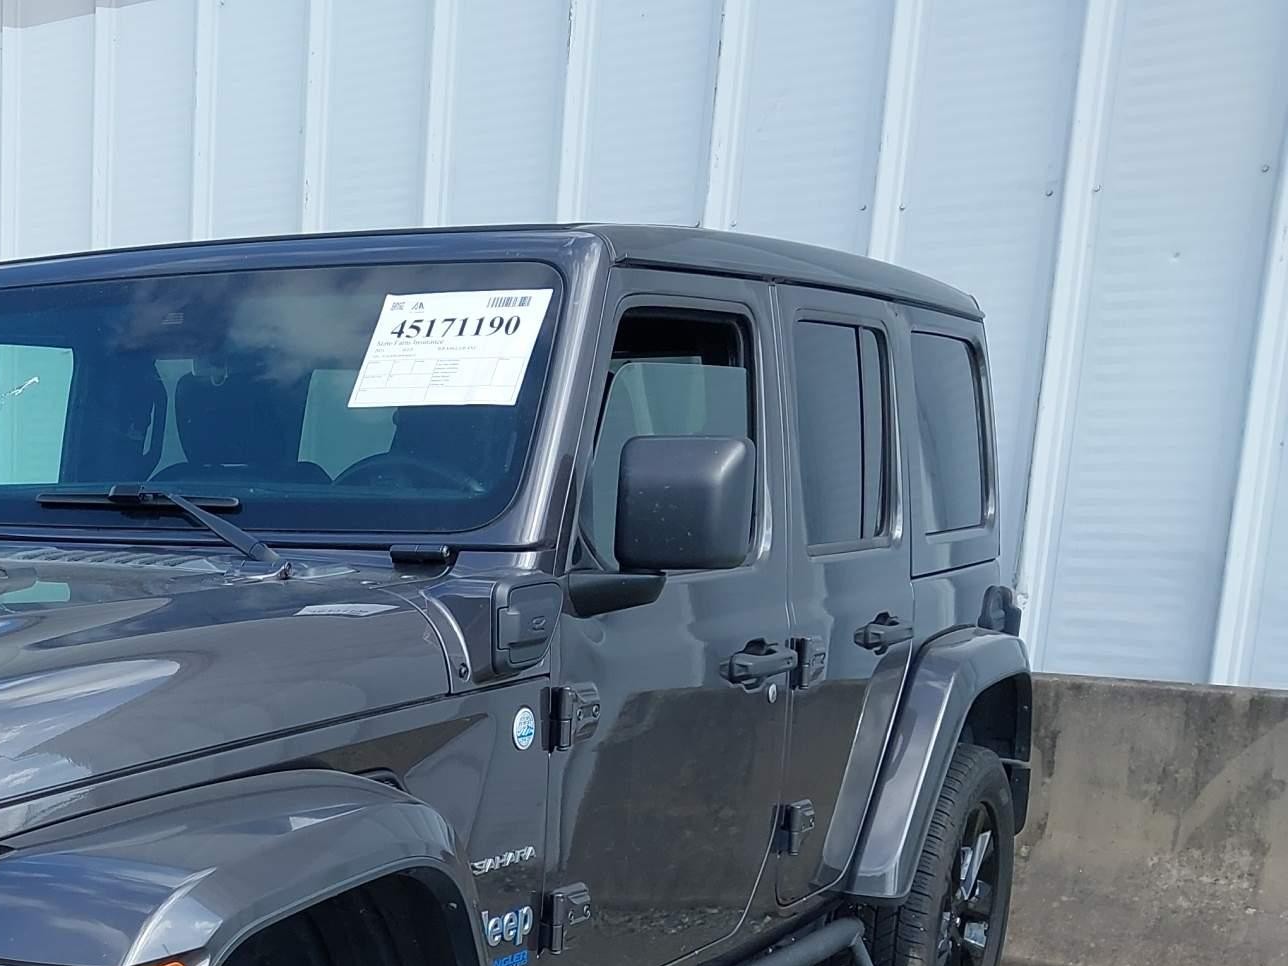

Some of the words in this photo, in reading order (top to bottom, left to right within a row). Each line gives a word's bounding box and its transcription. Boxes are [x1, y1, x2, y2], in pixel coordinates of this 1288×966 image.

[390, 315, 521, 338] 45171190
[472, 846, 536, 875] SAHARA
[481, 906, 533, 946] Jeep
